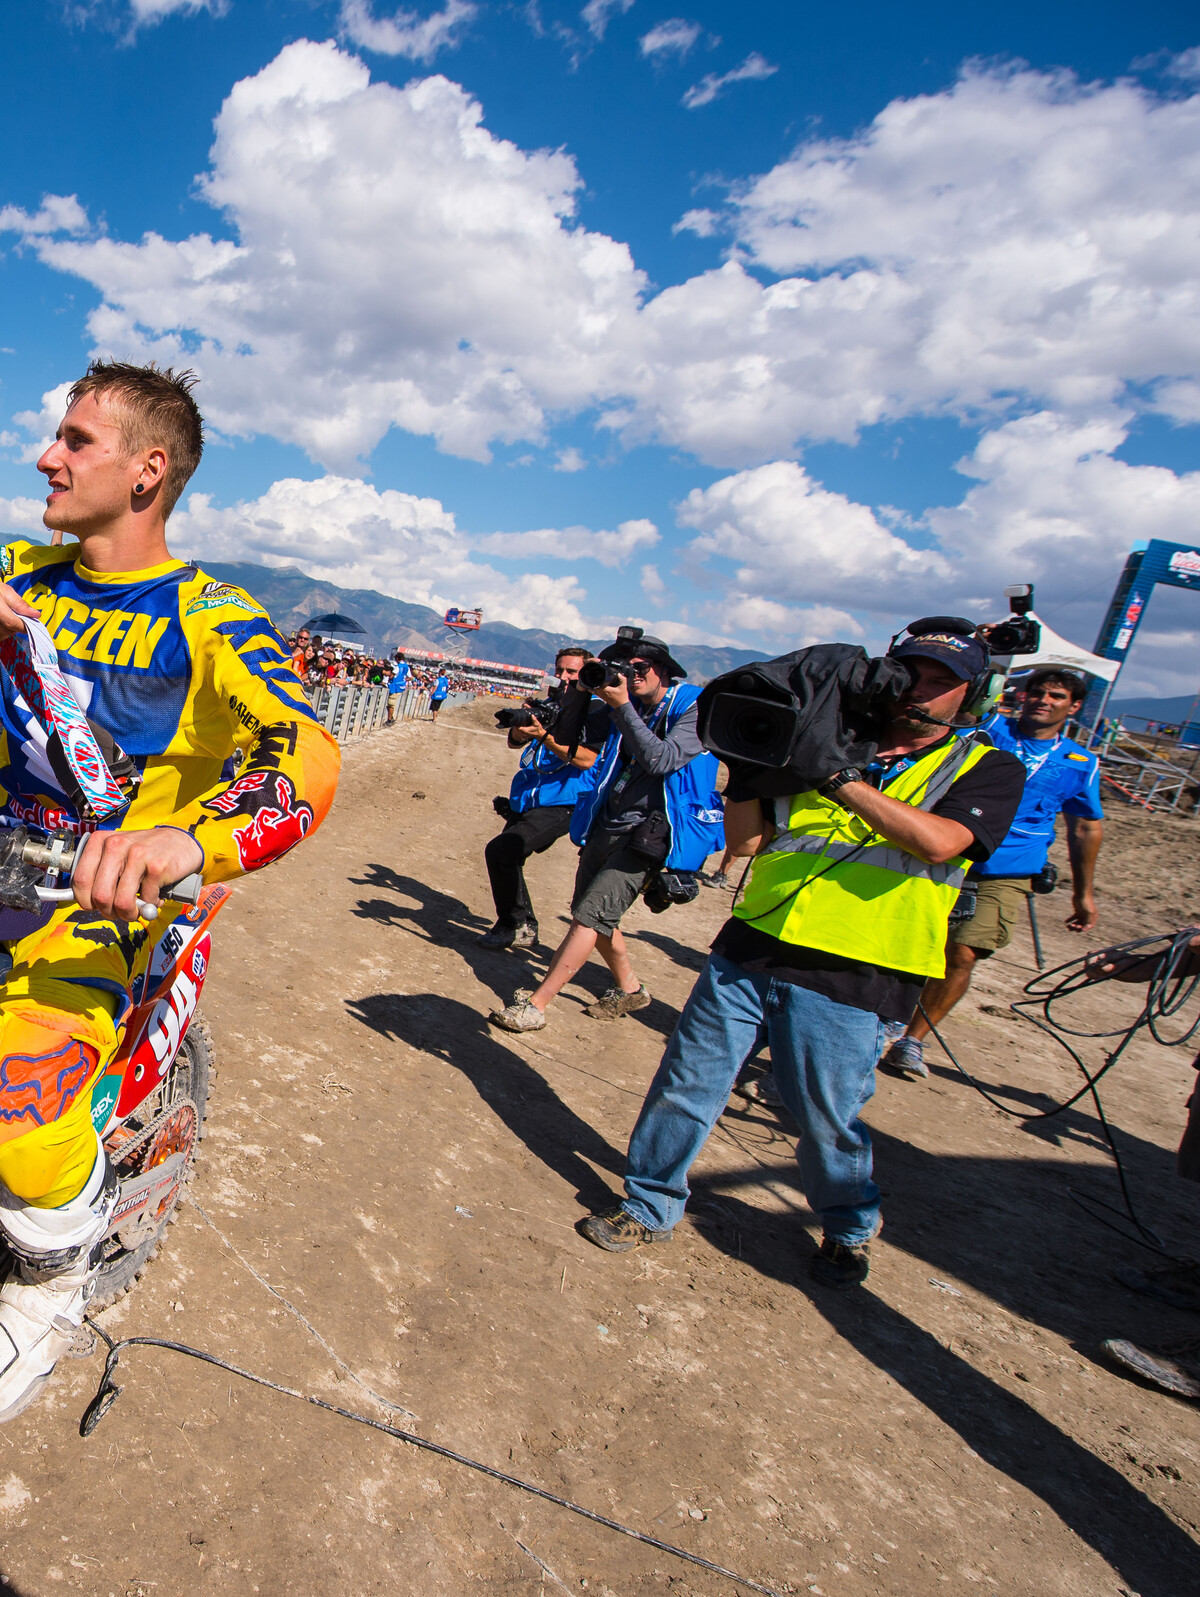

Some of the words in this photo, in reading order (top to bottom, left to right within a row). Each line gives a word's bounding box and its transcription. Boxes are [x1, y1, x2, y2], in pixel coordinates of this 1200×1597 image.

[203, 886, 227, 912] DUNLOP
[160, 926, 184, 959] 450
[148, 969, 198, 1077] 94
[113, 1188, 150, 1216] ENTHAL
